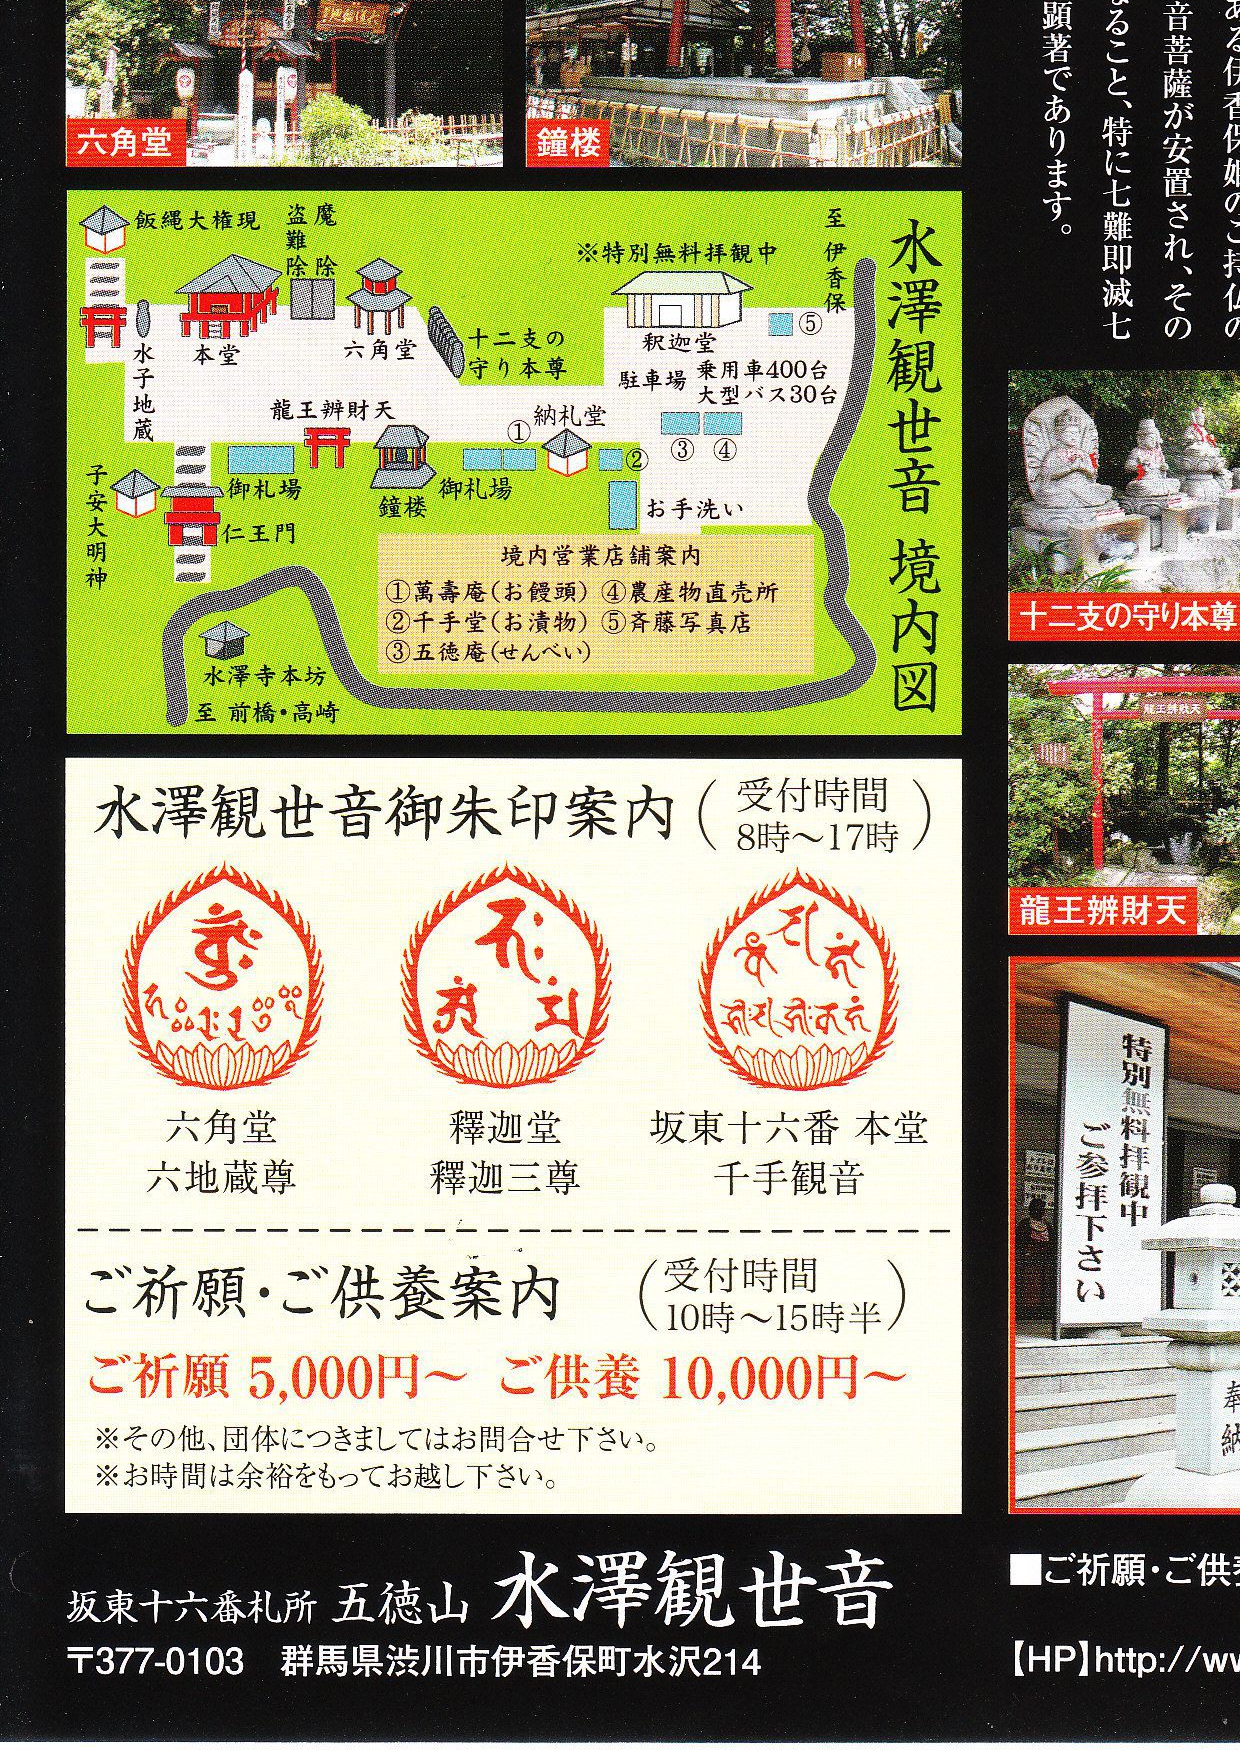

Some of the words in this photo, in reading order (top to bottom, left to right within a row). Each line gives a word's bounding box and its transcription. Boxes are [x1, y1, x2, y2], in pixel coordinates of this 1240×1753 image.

[77, 127, 171, 157] 六角堂
[537, 127, 600, 157] 鐘楼
[134, 210, 260, 231] 飯縄大権現
[825, 208, 845, 228] 至
[286, 203, 308, 277] 盗難除
[314, 203, 338, 277] 魔除
[578, 241, 777, 265] ※特別無料拝観中
[824, 242, 847, 313] 伊香保
[194, 344, 240, 365] 本堂
[344, 339, 416, 360] 六角堂
[468, 329, 565, 350] 十二支の
[643, 332, 716, 353] 釈迦堂
[468, 357, 567, 379] 守り本尊
[619, 369, 686, 391] 駐車場
[697, 359, 827, 382] 乗用車400台
[887, 219, 943, 514] 水澤観世音
[133, 343, 155, 442] 水子地蔵
[698, 385, 836, 405] 大型バス30台
[534, 404, 606, 427] 納札堂
[227, 478, 301, 500] 御札場
[438, 477, 512, 501] 御札場
[379, 495, 427, 518] 鐘楼
[648, 498, 742, 520] お手洗い
[85, 465, 108, 590] 子安大明神
[221, 522, 296, 544] 仁王門
[501, 544, 699, 567] 境内営業店舗案内
[601, 579, 780, 604] ④農産物直売所
[889, 538, 941, 712] 境内図
[1020, 601, 1237, 631] 十二支の守り本尊
[204, 664, 326, 687] 水澤寺本坊
[195, 703, 216, 722] 至
[228, 701, 339, 723] 前橋・高崎
[738, 777, 887, 813] 受付時間
[94, 784, 673, 841] 水澤観世音御朱印案内
[738, 821, 898, 853] 8時～17時
[1020, 895, 1186, 925] 龍王辨財天
[167, 1109, 276, 1144] 六角堂
[450, 1110, 560, 1145] 釋迦堂
[650, 1110, 839, 1145] 坂東十六番
[855, 1111, 928, 1145] 本堂
[1118, 1032, 1153, 1227] 特別無料拝観中
[148, 1159, 295, 1194] 六地蔵尊
[430, 1160, 580, 1195] 釋迦三尊
[714, 1160, 864, 1195] 千手観音
[1074, 1121, 1110, 1303] ご参拝下さい
[665, 1257, 816, 1293] 受付時間
[86, 1265, 558, 1320] ご祈願・ご供養案内
[668, 1302, 881, 1334] 10時～15時半
[90, 1353, 229, 1398] ご祈願
[250, 1355, 464, 1400] 5,000円～
[501, 1354, 638, 1399] ご供養
[666, 1355, 903, 1401] 10,000円～
[97, 1425, 655, 1452] ※その他、団体につきましてはお問合せ下さい。
[97, 1462, 554, 1489] ※お時間は余裕をもってお越し下さい。
[67, 1589, 317, 1624] 坂東十六番札所
[332, 1580, 468, 1625] 五徳山
[491, 1549, 893, 1629] 水澤観世音
[67, 1647, 243, 1675] 〒377-0103
[281, 1644, 761, 1677] 群馬県渋川市伊香保町水沢214
